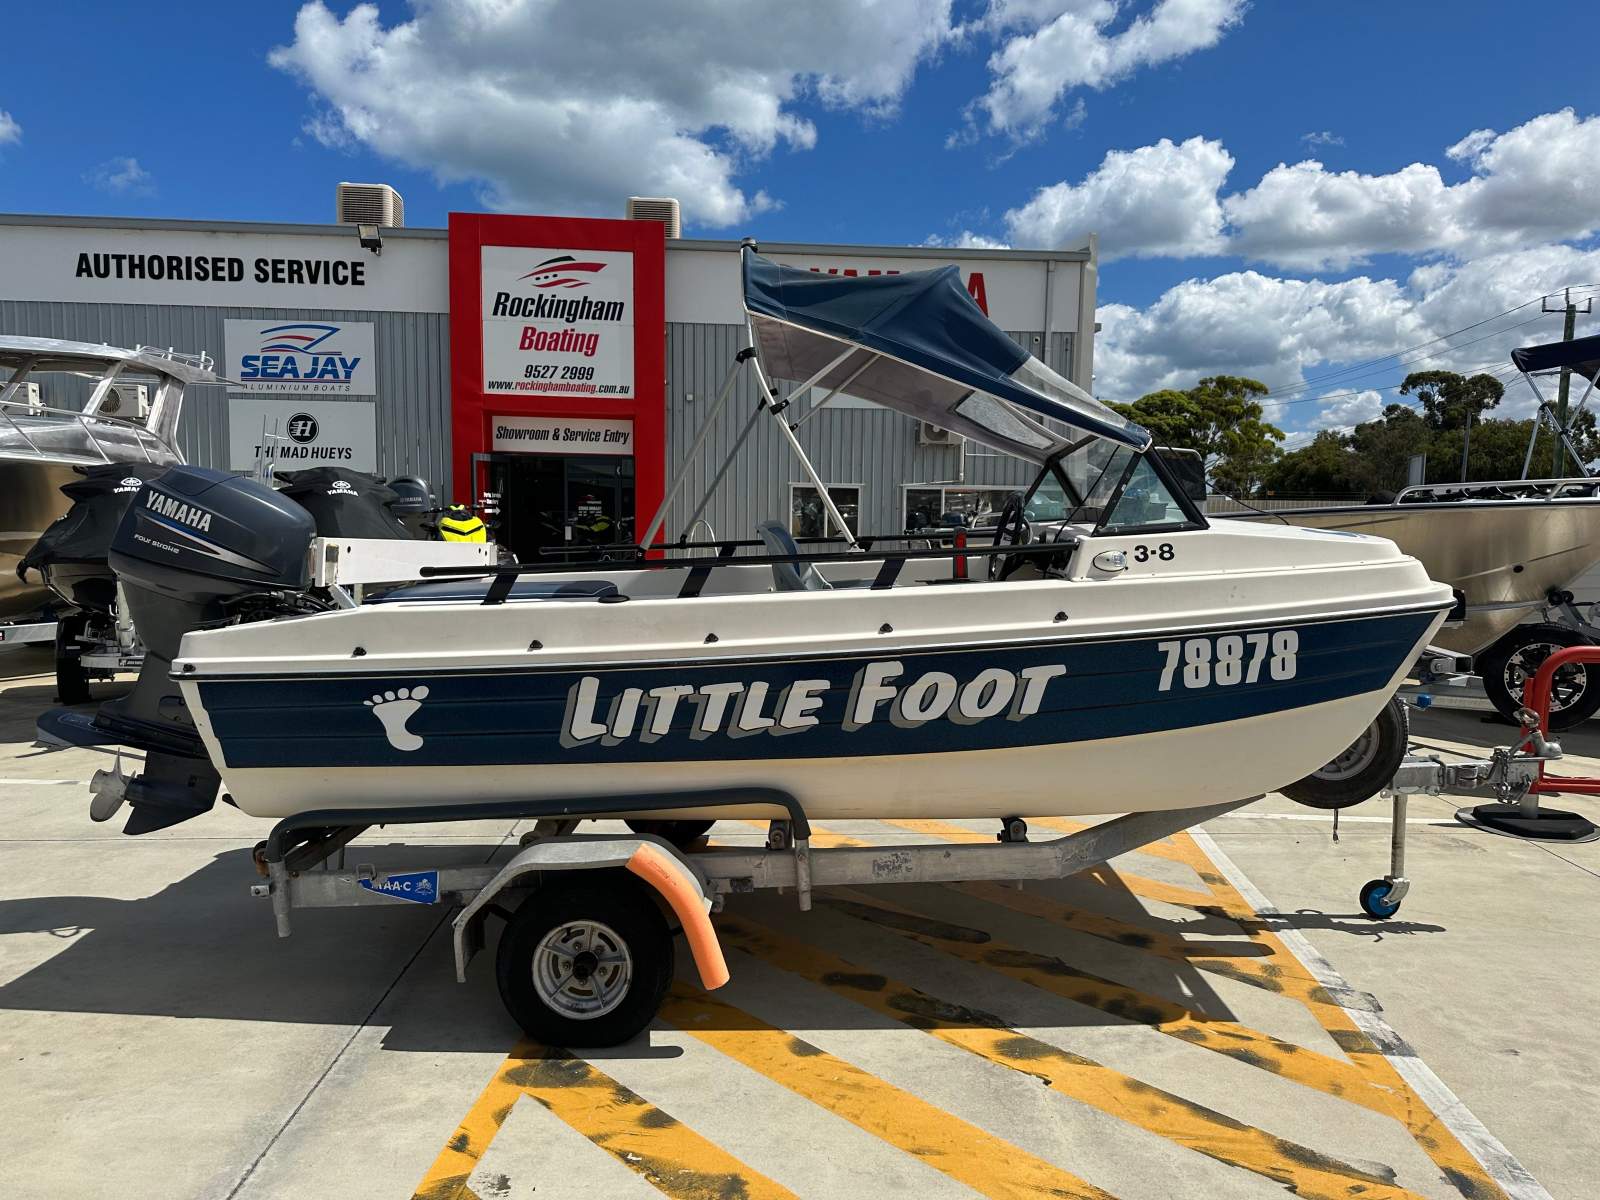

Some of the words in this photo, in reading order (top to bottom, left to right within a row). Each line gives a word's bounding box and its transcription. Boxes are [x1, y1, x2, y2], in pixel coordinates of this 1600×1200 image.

[76, 252, 244, 283] AUTHORISED
[254, 259, 365, 286] SERVICE
[492, 291, 625, 324] Rockingham
[518, 326, 600, 357] Boating
[240, 355, 300, 380] SEA
[303, 355, 361, 380] JAY
[524, 364, 558, 380] 9527
[560, 365, 595, 381] 2999
[242, 384, 310, 392] ALUMINIUM
[487, 380, 630, 396] www.rockinghamboating.com.au
[496, 425, 550, 441] Showroom
[551, 428, 560, 441] &
[562, 427, 601, 443] Service
[602, 429, 630, 445] Entry
[280, 446, 308, 459] MAD
[311, 447, 352, 460] HUEYS
[326, 488, 359, 497] YAMAHA
[145, 489, 212, 533] YAMAHA
[1157, 630, 1299, 692] 78878
[563, 676, 831, 745] LITTLE
[845, 660, 1066, 730] FOOT
